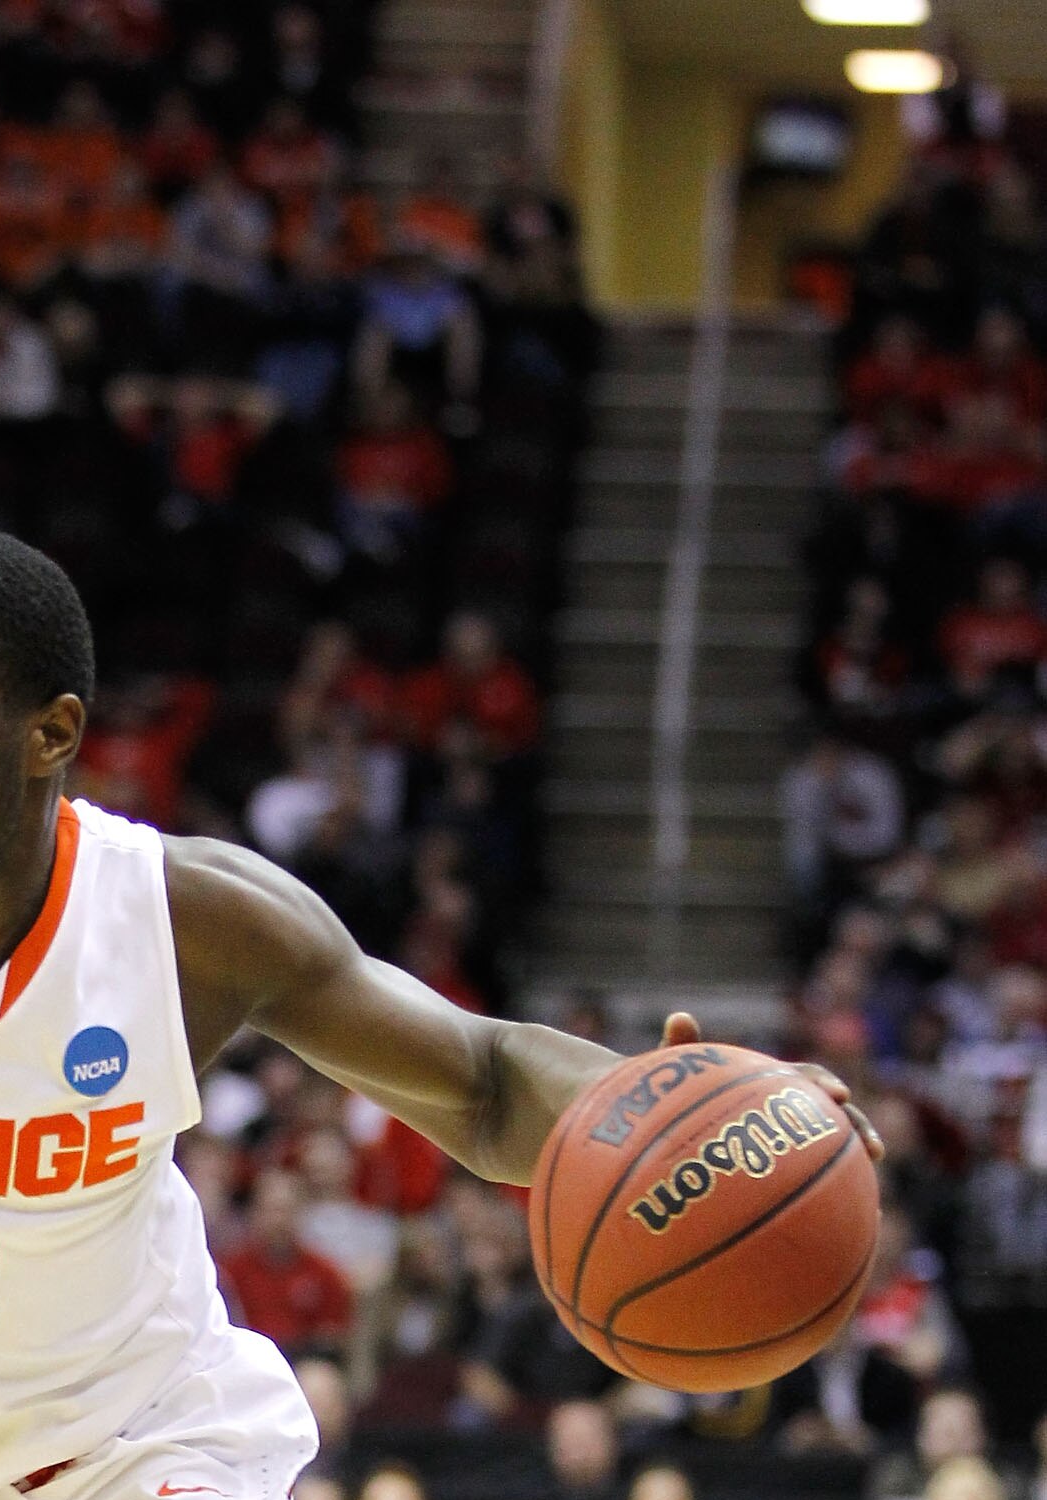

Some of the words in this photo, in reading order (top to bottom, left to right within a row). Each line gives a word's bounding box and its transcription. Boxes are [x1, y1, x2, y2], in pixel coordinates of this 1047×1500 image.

[72, 1056, 121, 1082] NCAA
[592, 1048, 728, 1147] NCAA
[627, 1088, 839, 1234] Wilson
